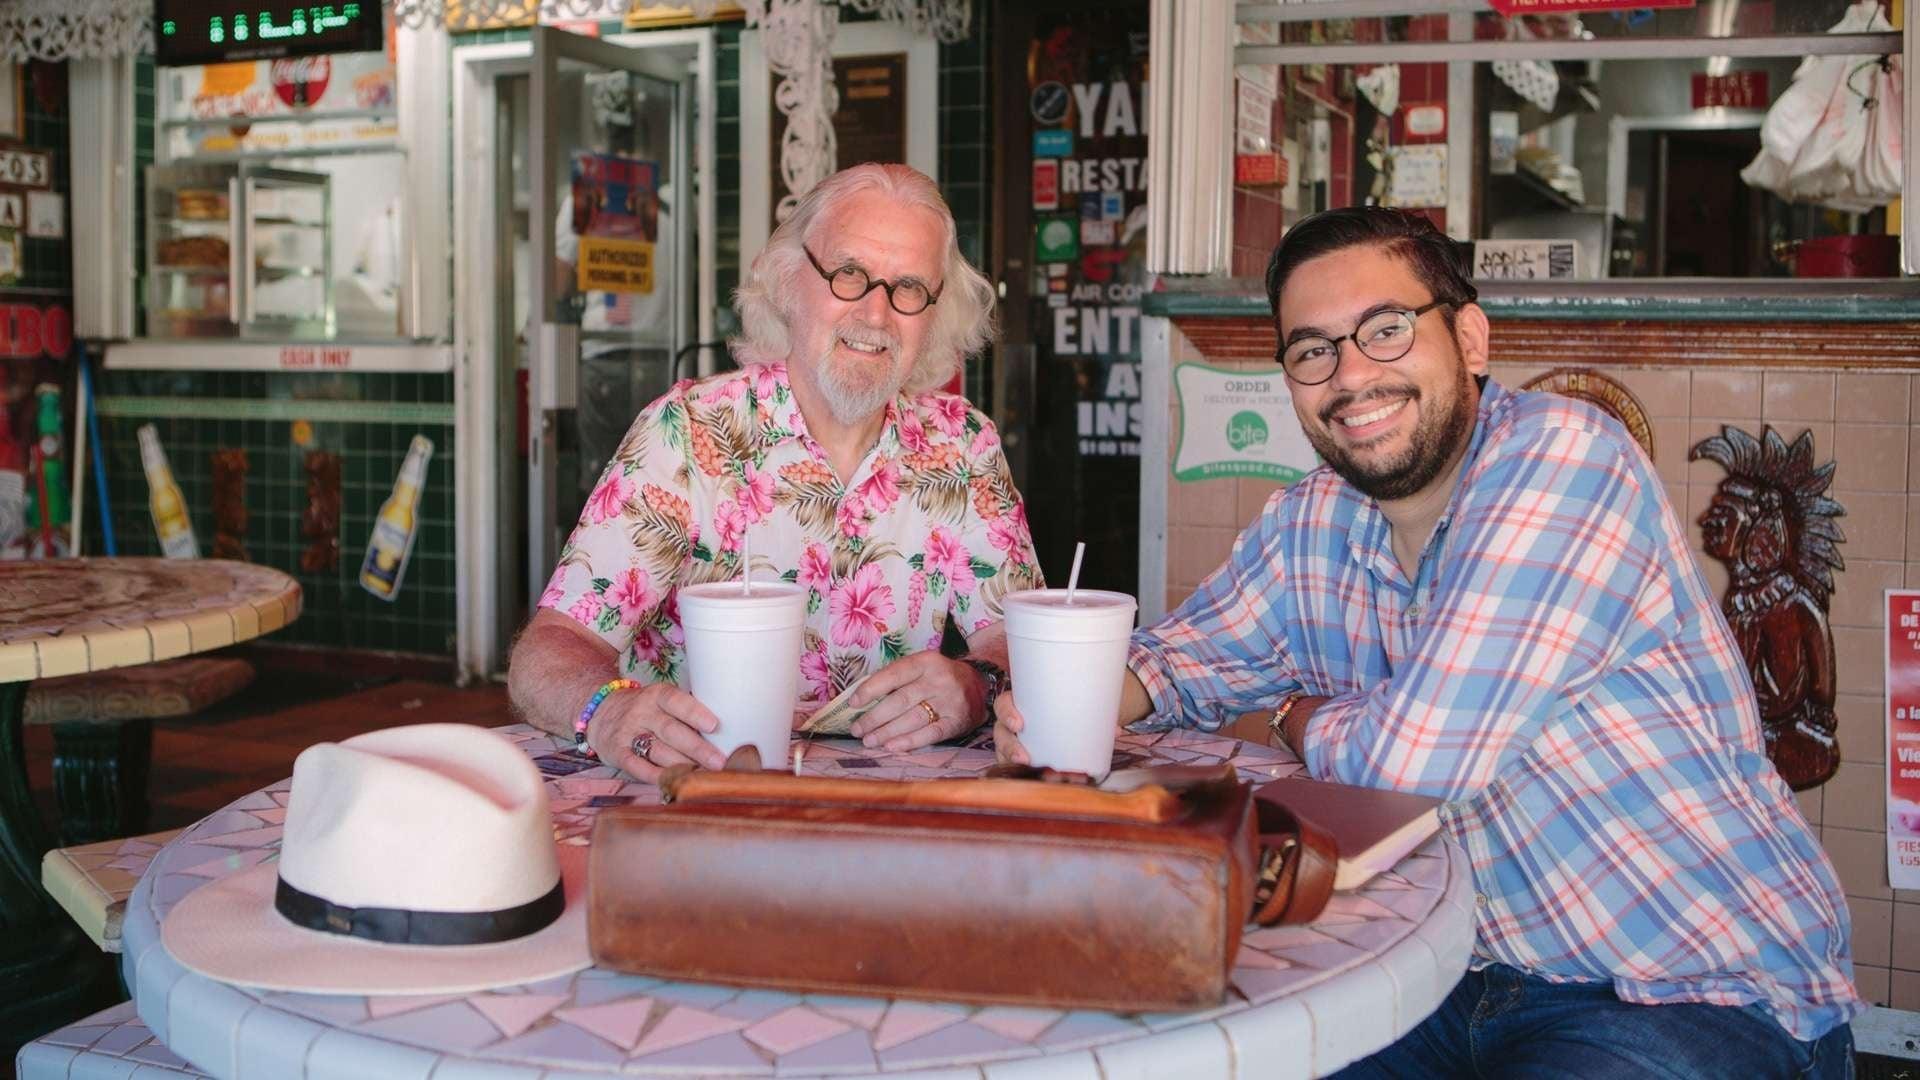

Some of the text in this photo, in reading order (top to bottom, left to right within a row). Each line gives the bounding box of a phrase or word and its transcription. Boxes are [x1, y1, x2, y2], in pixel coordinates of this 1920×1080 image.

[1071, 283, 1102, 301] AIR
[1105, 362, 1141, 398] A
[1224, 381, 1271, 392] ORDER
[1229, 420, 1267, 444] bite
[1900, 614, 1919, 628] DE
